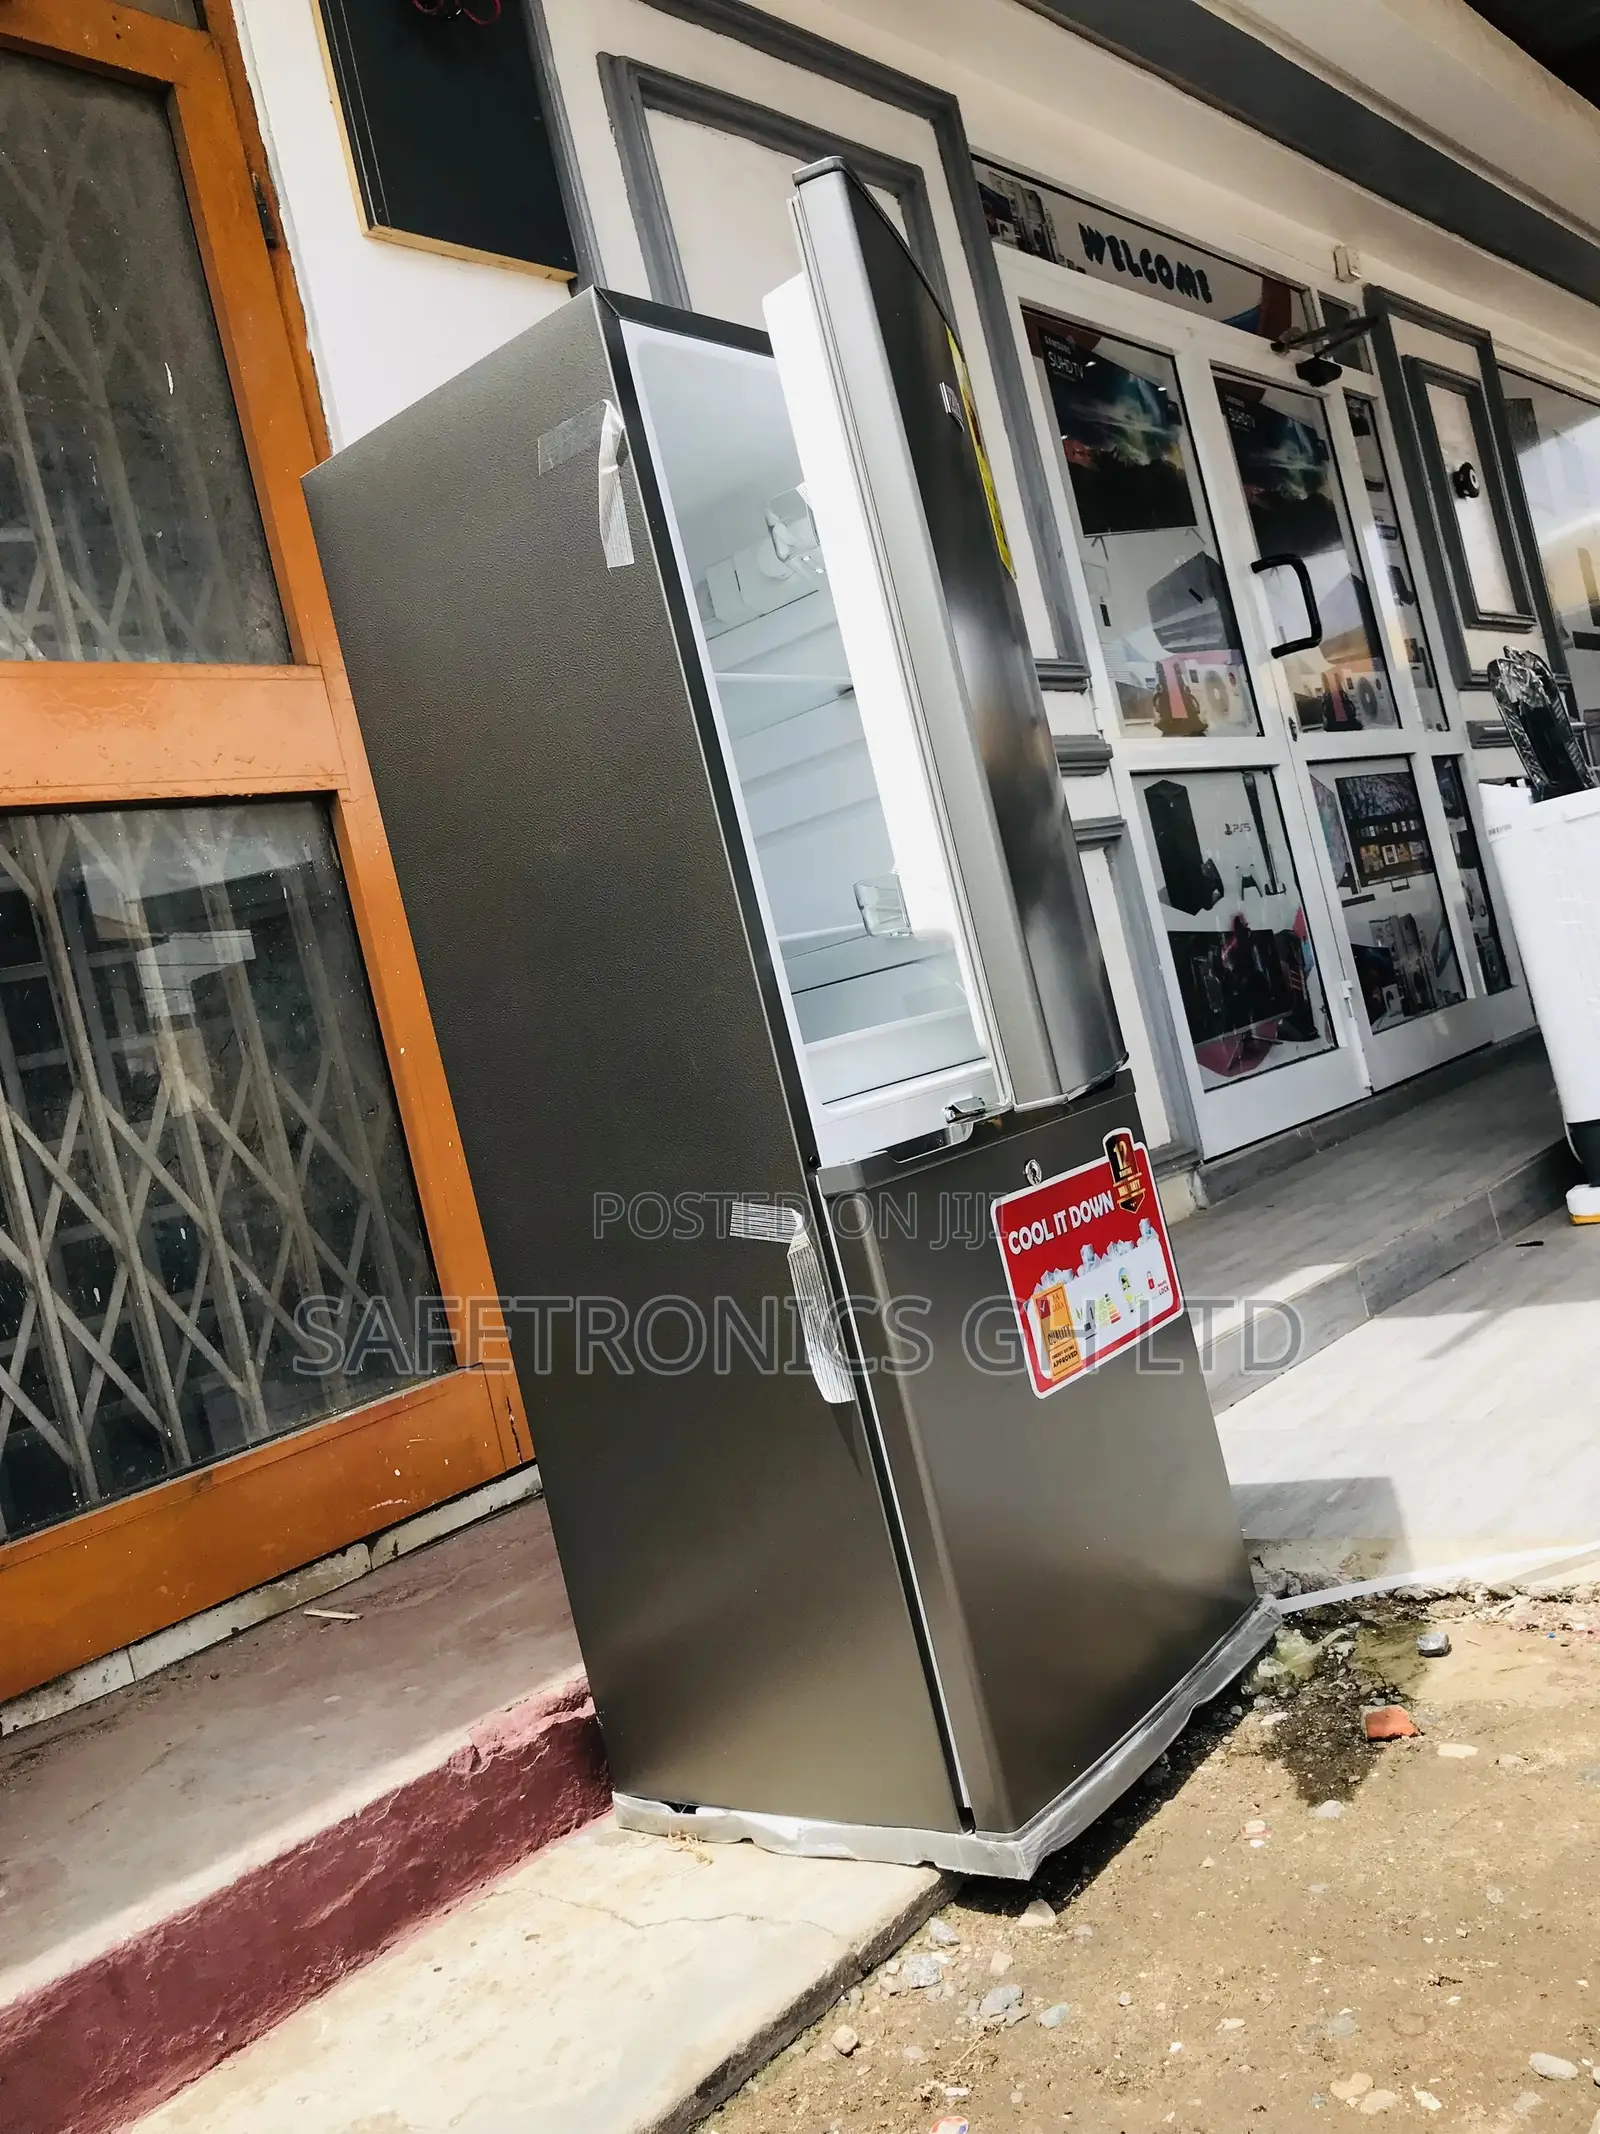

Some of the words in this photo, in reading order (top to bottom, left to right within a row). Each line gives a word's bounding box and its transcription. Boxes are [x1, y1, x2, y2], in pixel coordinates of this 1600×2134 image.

[1077, 221, 1213, 305] WELCOME
[1113, 1140, 1130, 1170] 12
[1007, 1216, 1055, 1256] COOL
[1053, 1211, 1069, 1236] IT
[1070, 1189, 1116, 1229] DOWN
[1052, 1350, 1079, 1369] APPROVED
